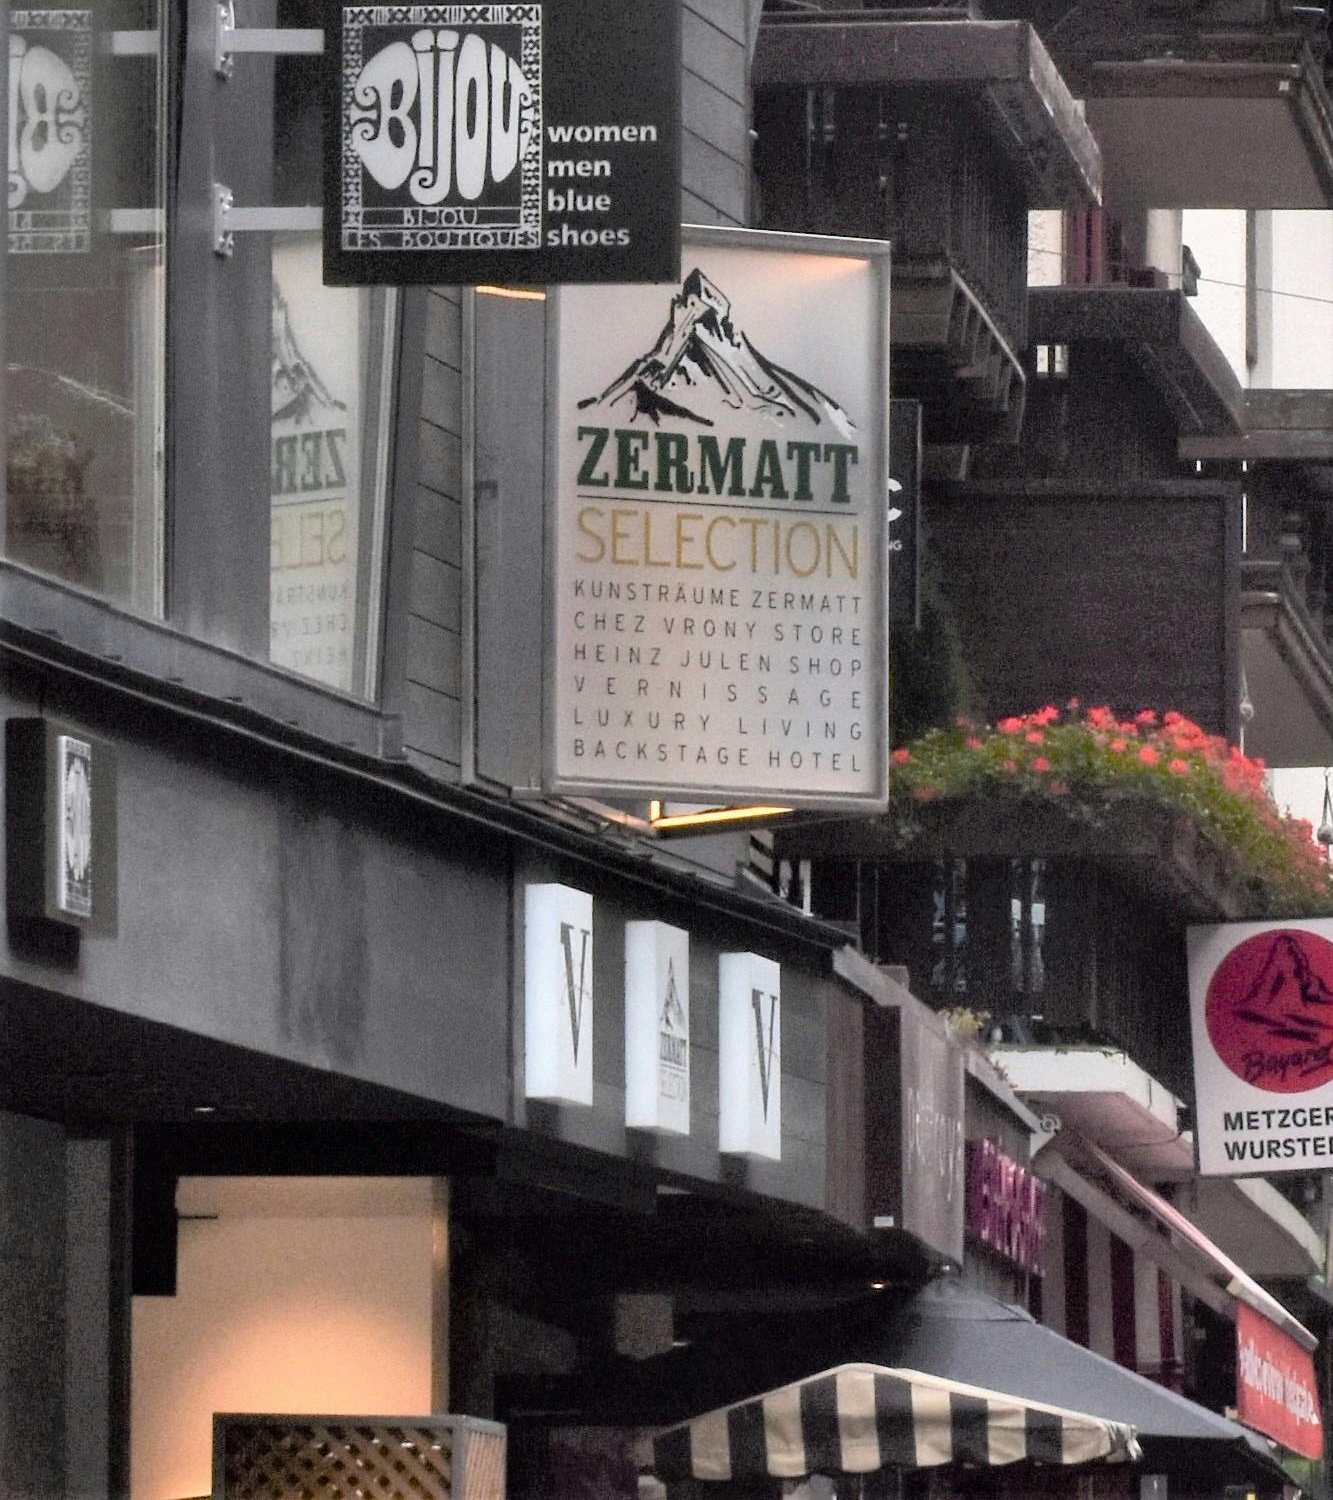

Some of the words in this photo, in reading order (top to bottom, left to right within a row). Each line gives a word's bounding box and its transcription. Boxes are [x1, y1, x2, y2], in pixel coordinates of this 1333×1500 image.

[548, 124, 657, 143] women
[548, 159, 611, 177] men
[548, 188, 611, 211] blue
[403, 207, 478, 227] BIJOU
[547, 221, 631, 245] shoes
[403, 230, 537, 248] BOUTIQUES
[577, 426, 859, 503] ZERMATT
[576, 505, 859, 580] SELECTION
[575, 579, 740, 608] KUNSTRÄUME
[751, 589, 862, 614] ZERMATT
[575, 611, 645, 633] CHEZ
[664, 617, 756, 638] VRONY
[774, 623, 862, 646] STORE
[575, 643, 661, 665] HEINZ
[681, 649, 771, 673] JULEN
[789, 655, 862, 677] SHOP
[575, 676, 862, 709] VERNISSAGE
[574, 709, 710, 731] LUXURY
[739, 717, 862, 740] LIVING
[574, 739, 749, 766] BACKSTAGE
[769, 751, 861, 772] HOTEL
